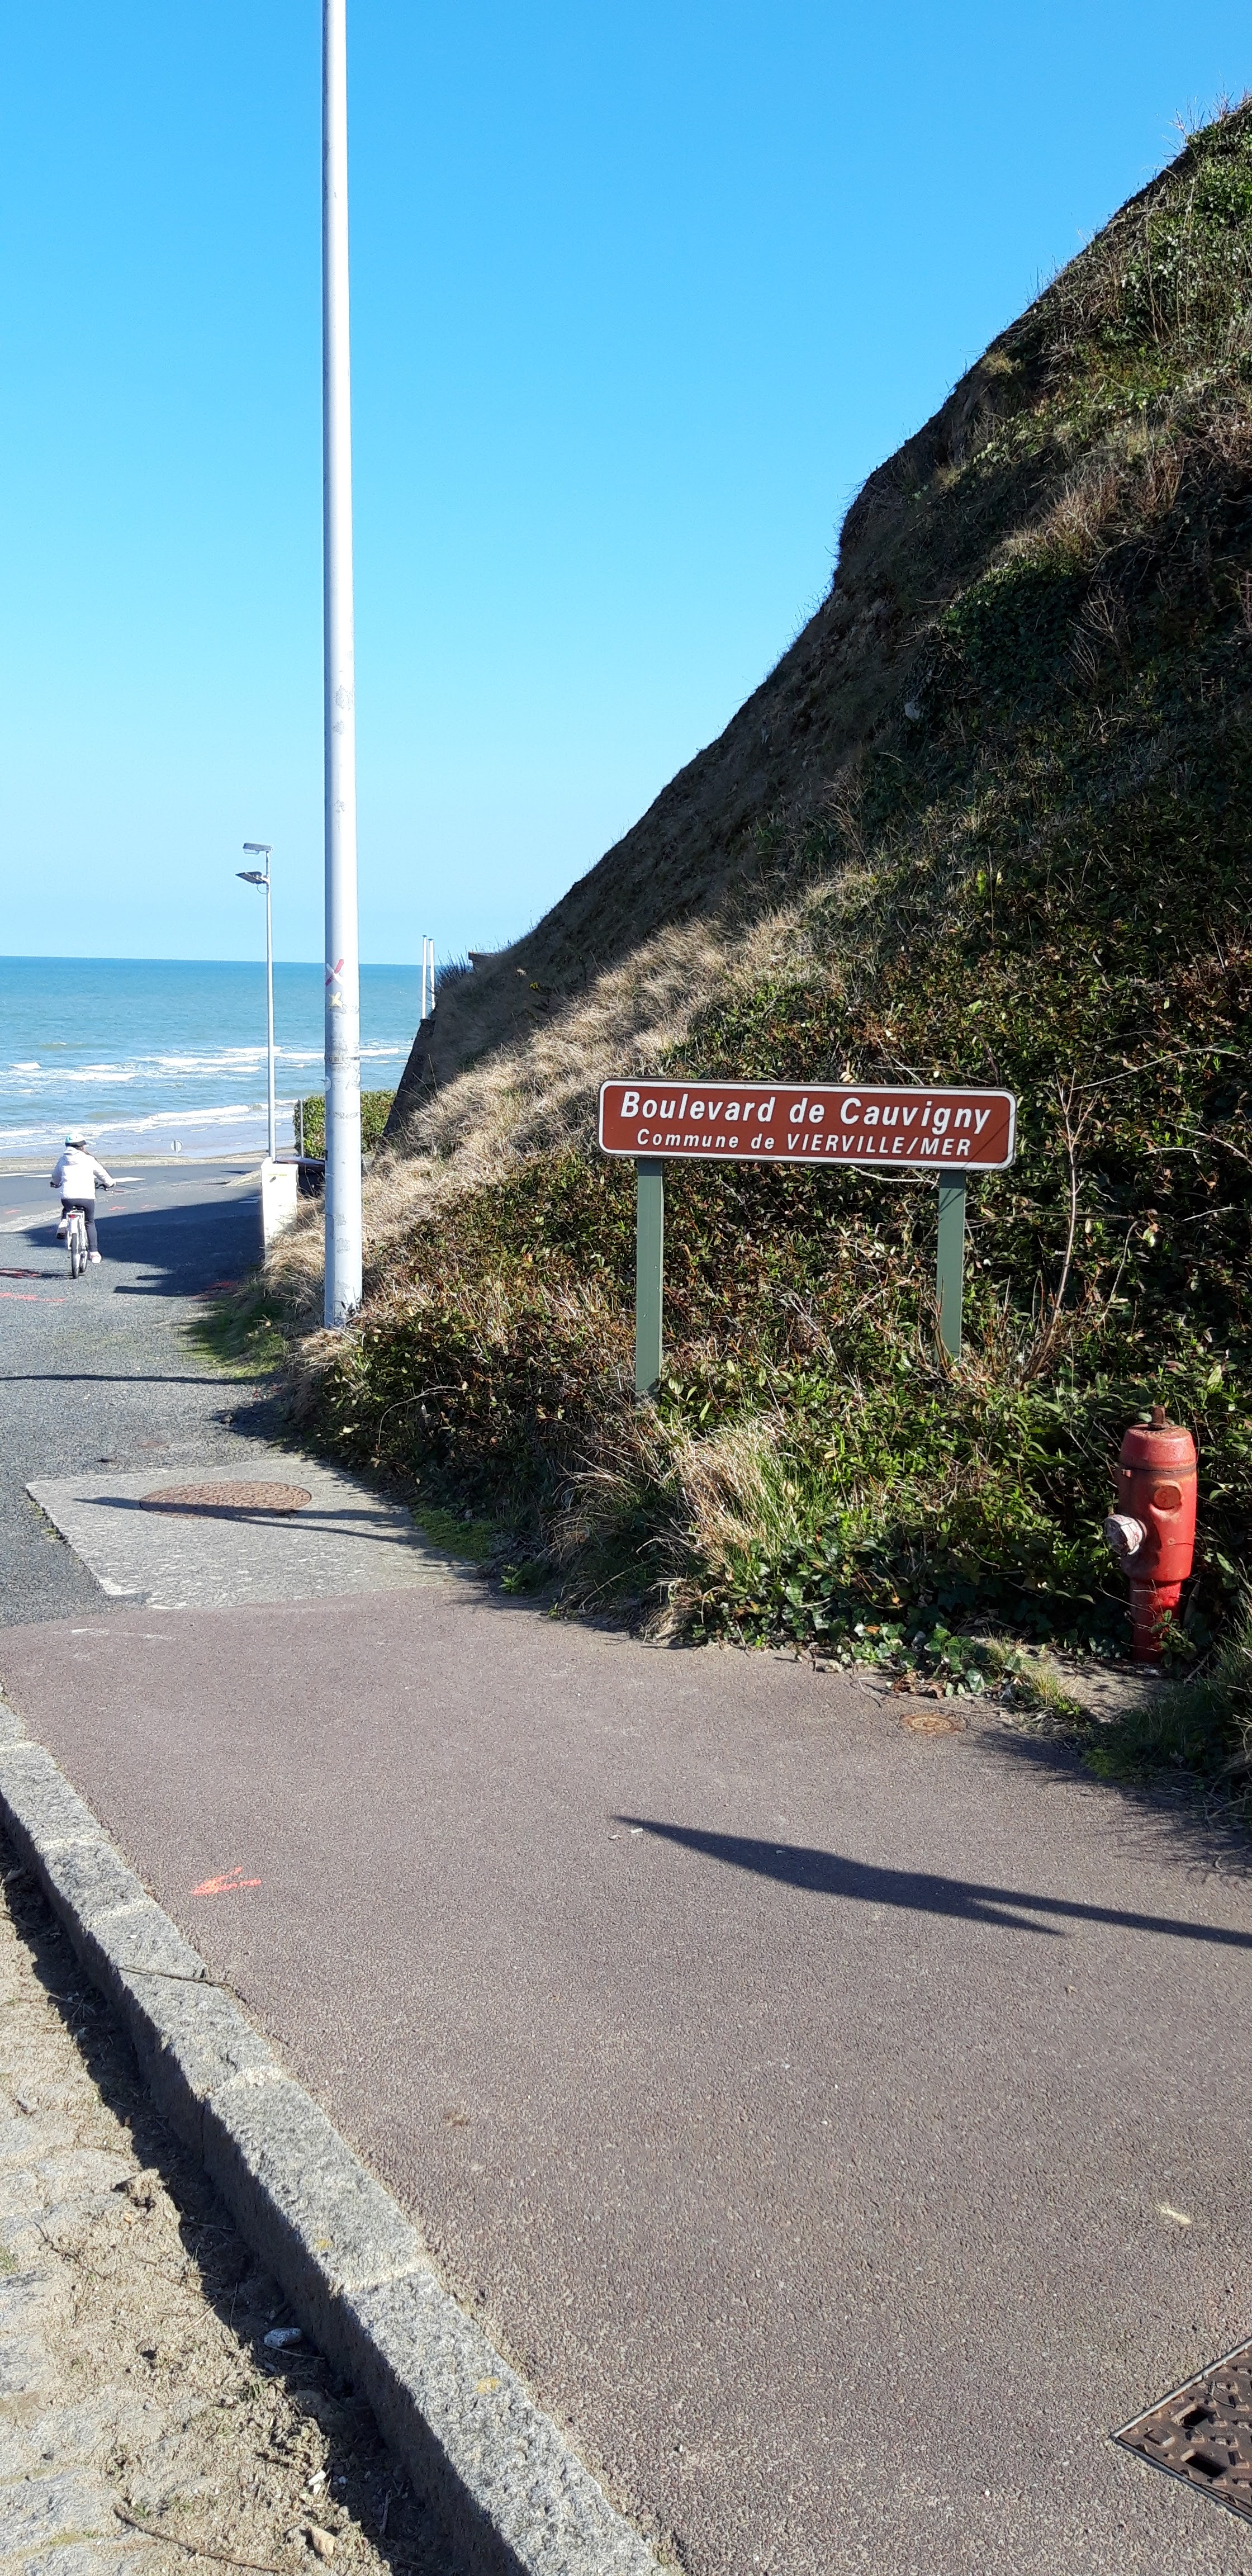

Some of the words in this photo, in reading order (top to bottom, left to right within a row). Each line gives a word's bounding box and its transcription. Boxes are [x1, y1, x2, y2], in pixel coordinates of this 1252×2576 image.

[620, 1091, 776, 1123] Boulevard
[789, 1097, 824, 1124] de
[840, 1097, 992, 1135] Cauvigny
[637, 1128, 738, 1149] Commune
[751, 1133, 775, 1150] de
[788, 1134, 971, 1157] VIERVILLE/MER
